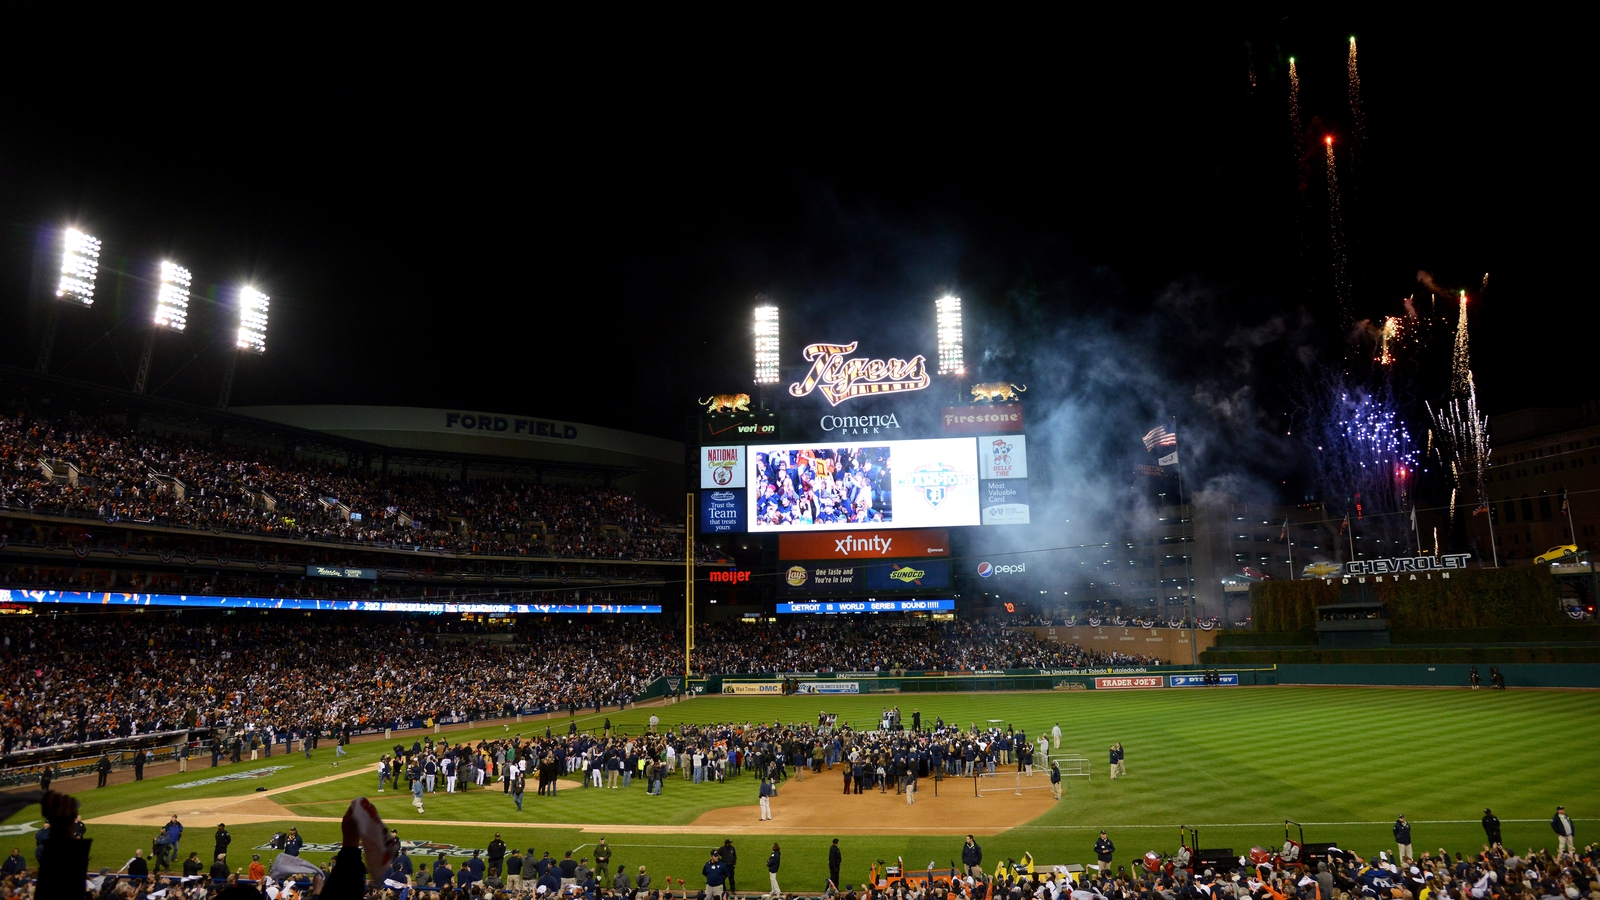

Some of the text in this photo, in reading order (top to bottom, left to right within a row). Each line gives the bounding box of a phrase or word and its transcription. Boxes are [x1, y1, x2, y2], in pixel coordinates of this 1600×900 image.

[789, 341, 930, 407] Tigers
[944, 413, 1019, 426] Firestone
[446, 412, 578, 440] FORD FIELD
[738, 423, 775, 434] verizon
[842, 427, 880, 435] PARK
[708, 449, 738, 461] NATIONAL
[708, 508, 737, 518] Team
[835, 535, 892, 555] xfinity
[995, 563, 1026, 575] pepsi
[1346, 553, 1472, 576] CHEVROLET
[710, 568, 751, 584] meijer
[828, 568, 841, 576] Taste
[891, 571, 924, 579] SUNOCO
[815, 576, 831, 584] You're
[1327, 572, 1450, 586] FOUNTAIN
[839, 603, 865, 611] WORLD
